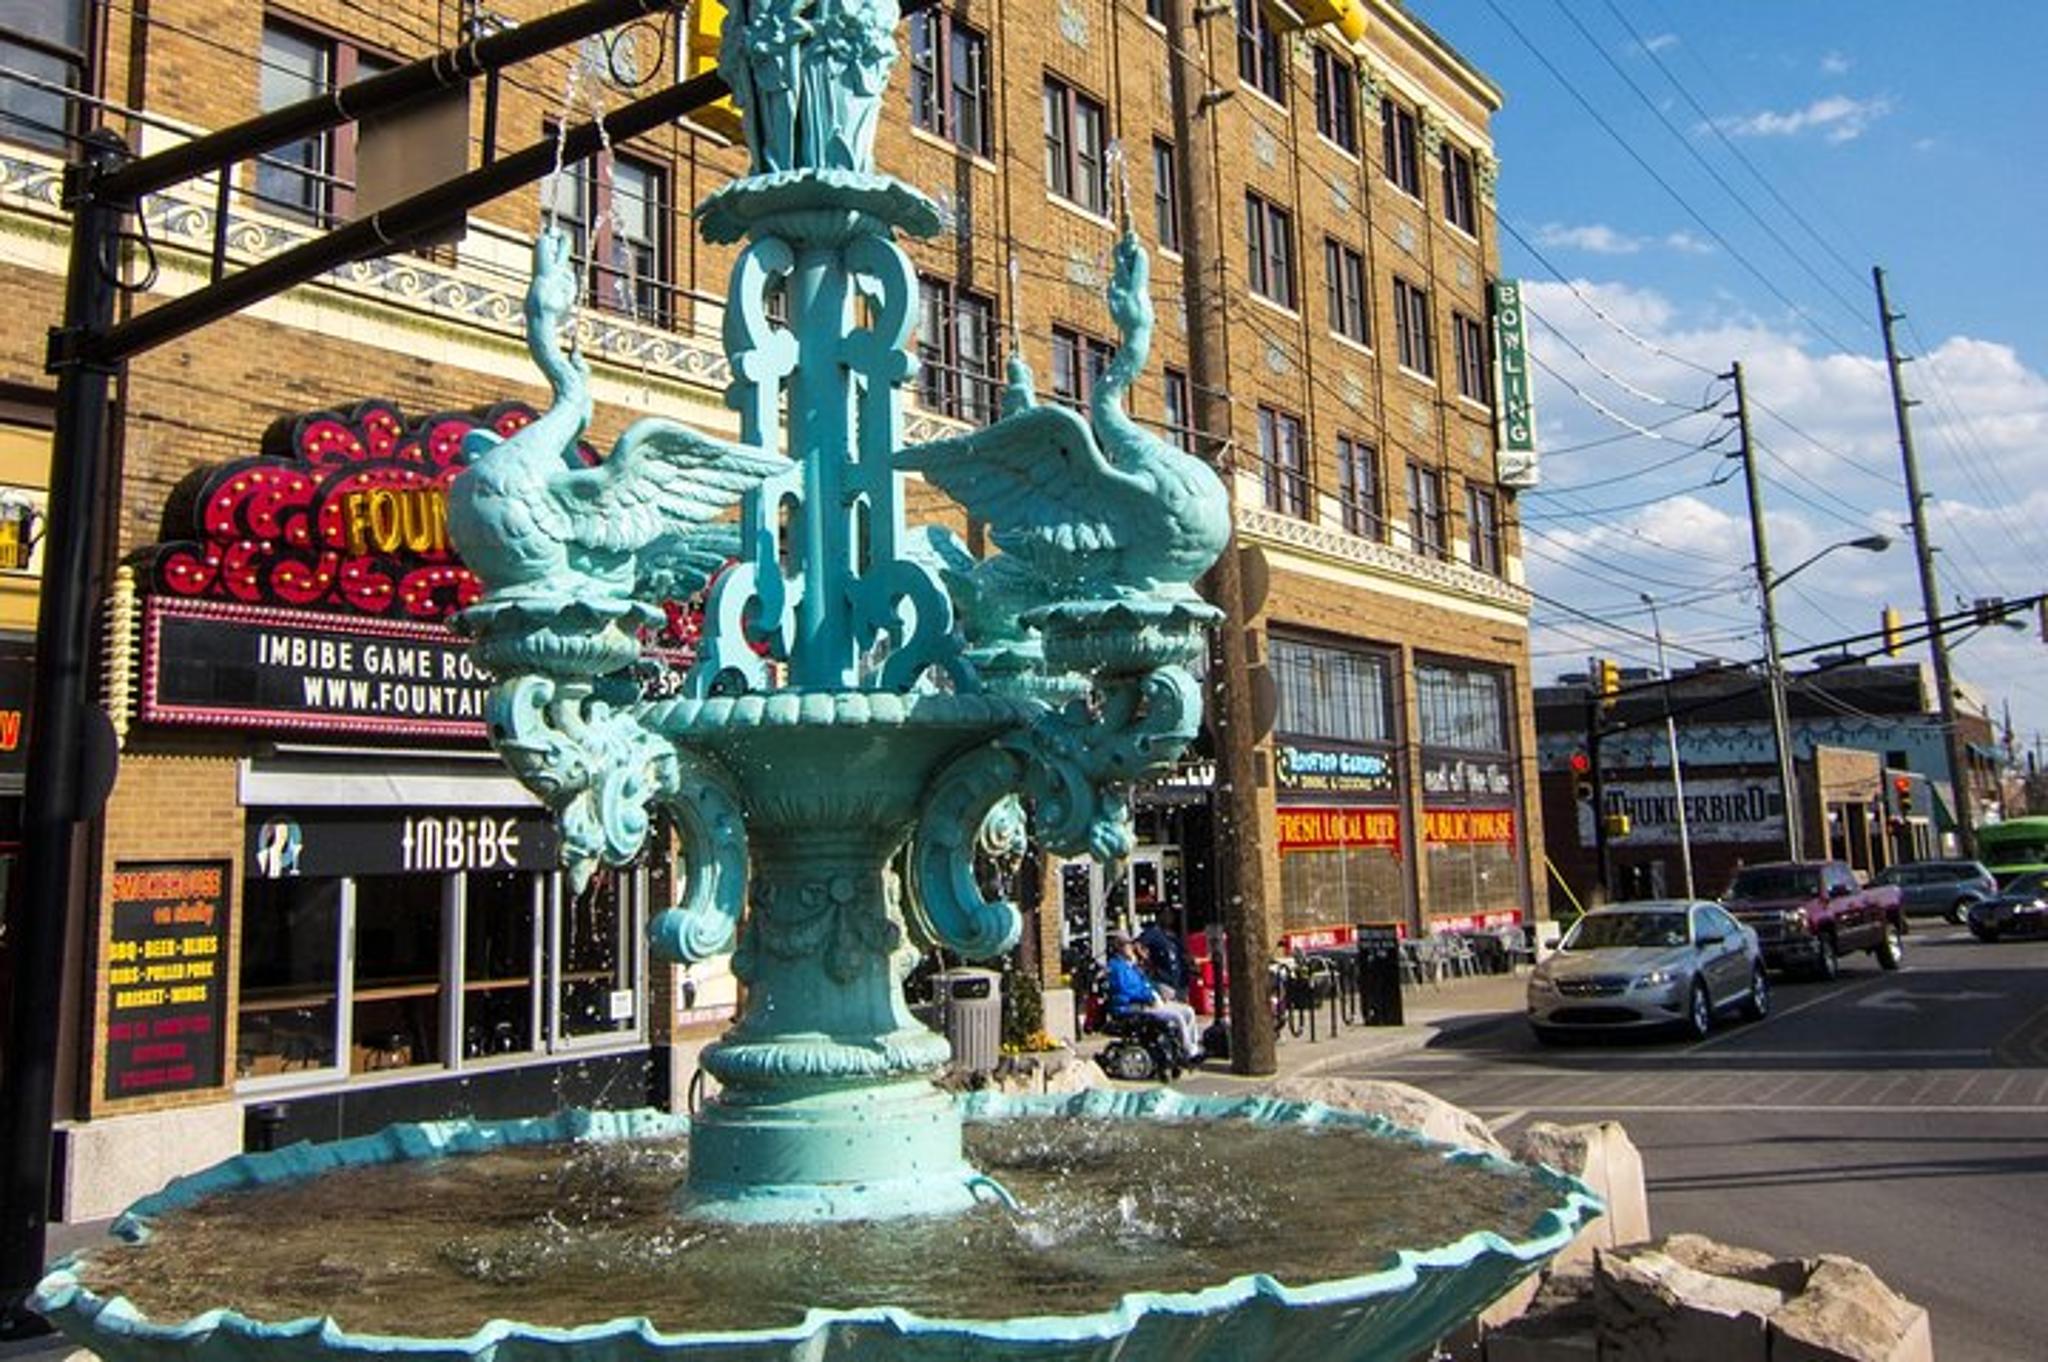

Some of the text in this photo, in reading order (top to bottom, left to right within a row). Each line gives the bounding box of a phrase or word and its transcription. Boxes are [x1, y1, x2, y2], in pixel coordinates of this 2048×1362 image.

[1501, 286, 1528, 443] BOWLING
[258, 634, 496, 683] IMBIBE GAME RO
[1606, 787, 1766, 826] THUNDERBIRD
[1277, 812, 1395, 841] FRESH LOCAL BEER
[1422, 812, 1511, 839] PUBLIC HOUSE
[112, 869, 221, 900] SMOKEHOUSE
[144, 939, 175, 958] BEER
